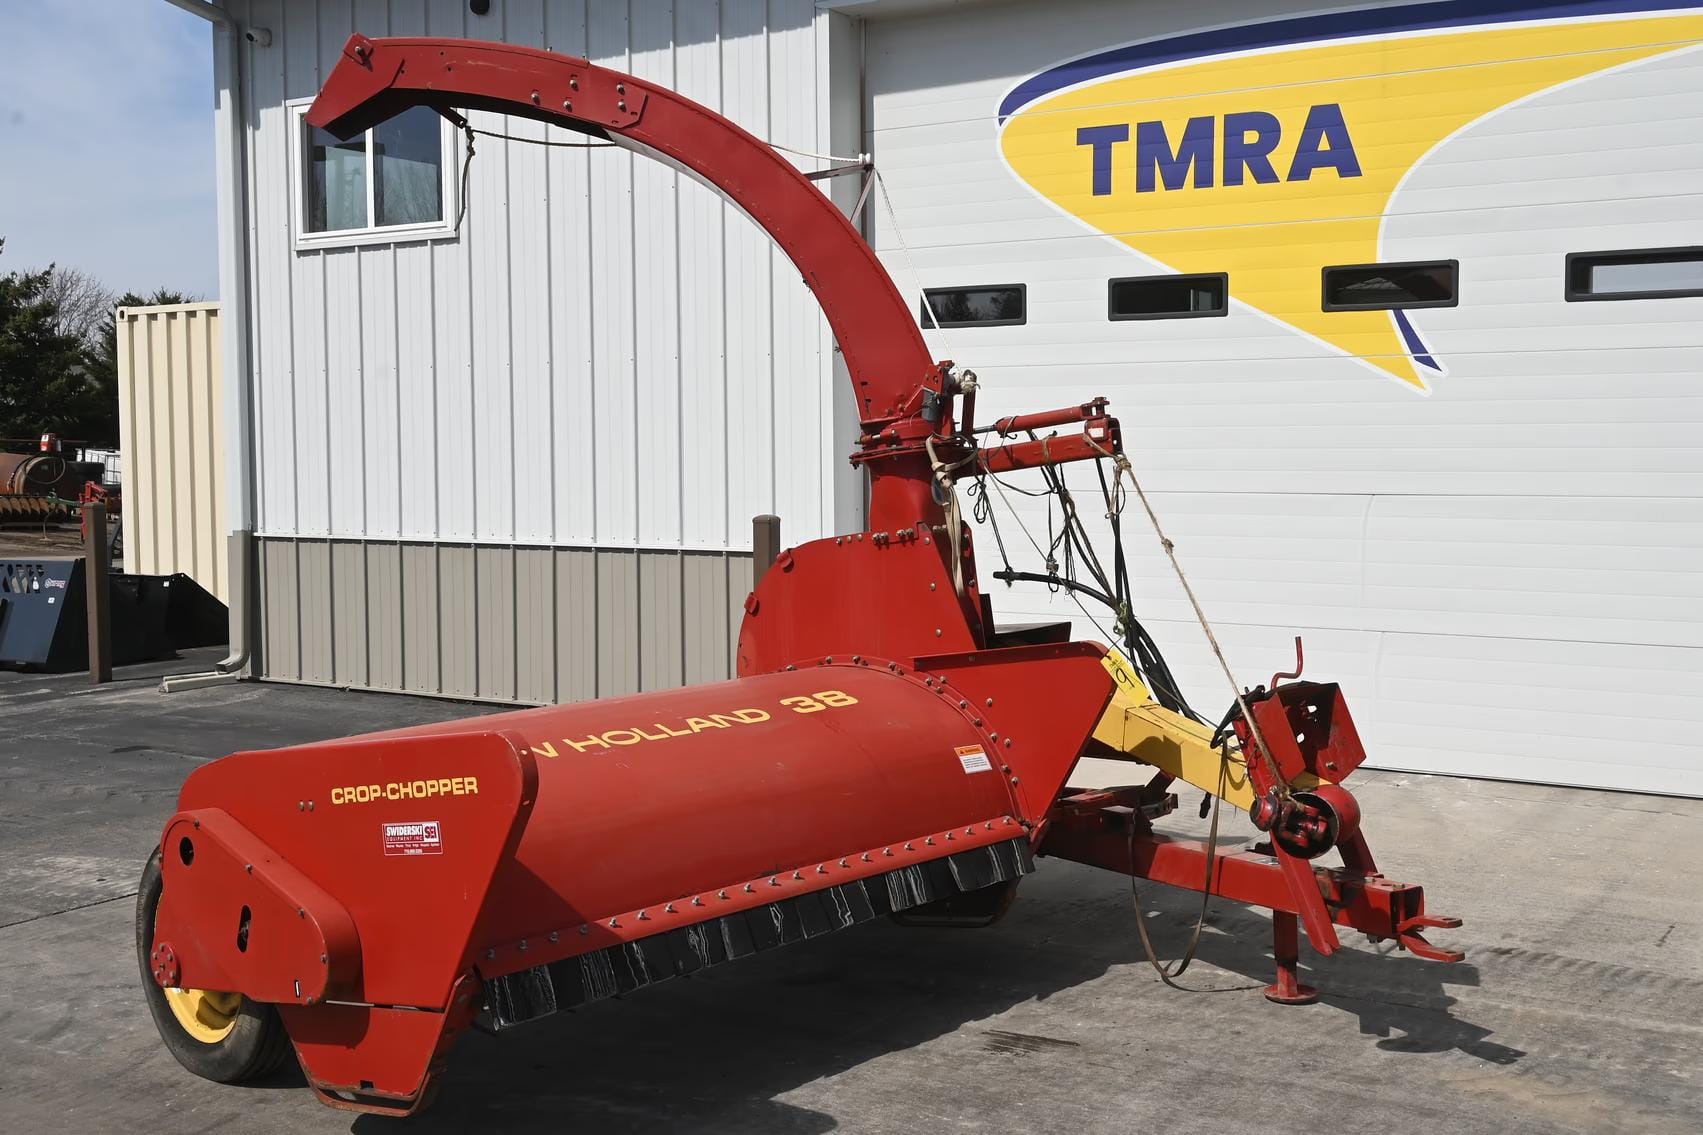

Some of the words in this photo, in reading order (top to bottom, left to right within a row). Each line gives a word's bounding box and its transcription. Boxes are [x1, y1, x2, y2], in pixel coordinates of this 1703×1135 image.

[1077, 103, 1363, 197] TMRA
[562, 708, 771, 753] HOLLAND
[779, 690, 859, 713] 38
[331, 776, 479, 805] CROP-CHOPPER
[386, 826, 422, 836] SWIDERSKI
